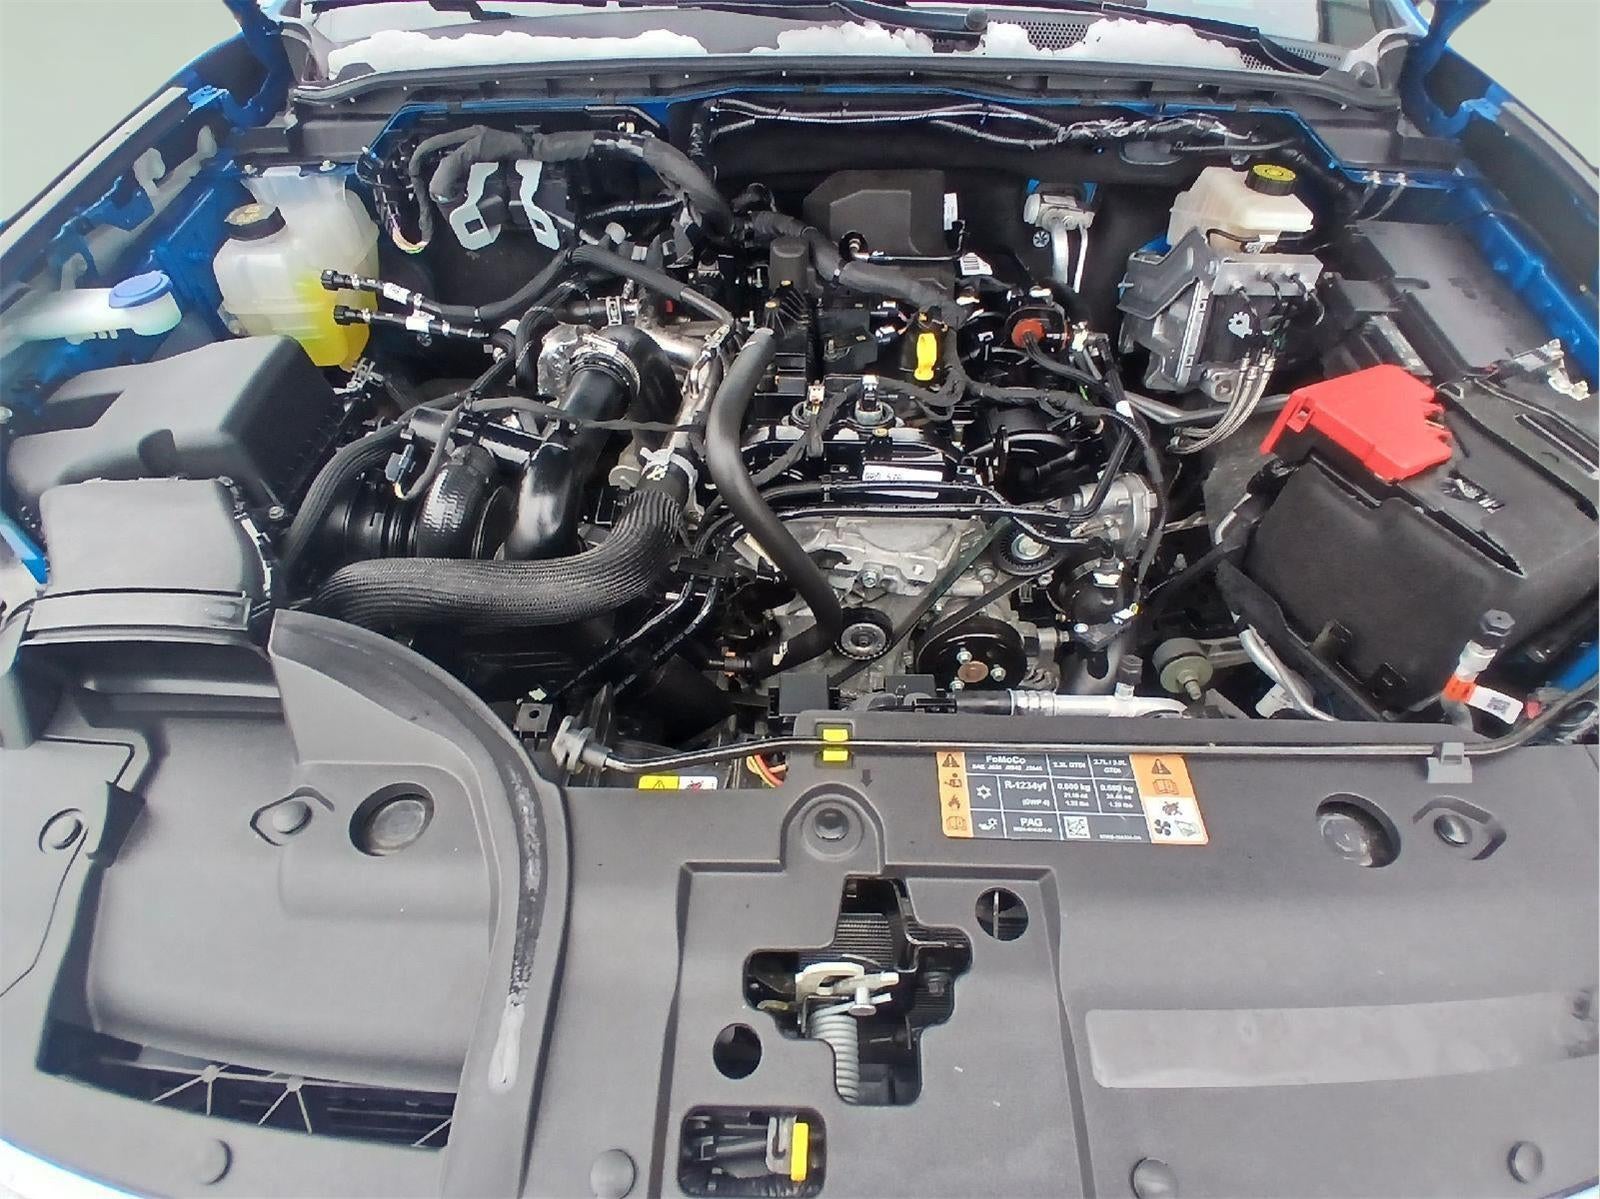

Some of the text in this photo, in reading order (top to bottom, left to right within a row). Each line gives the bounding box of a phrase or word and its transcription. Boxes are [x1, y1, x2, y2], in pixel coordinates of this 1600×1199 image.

[986, 755, 1027, 765] FoMoCo
[1004, 780, 1047, 792] R-1234yf
[1020, 817, 1043, 827] PAG
